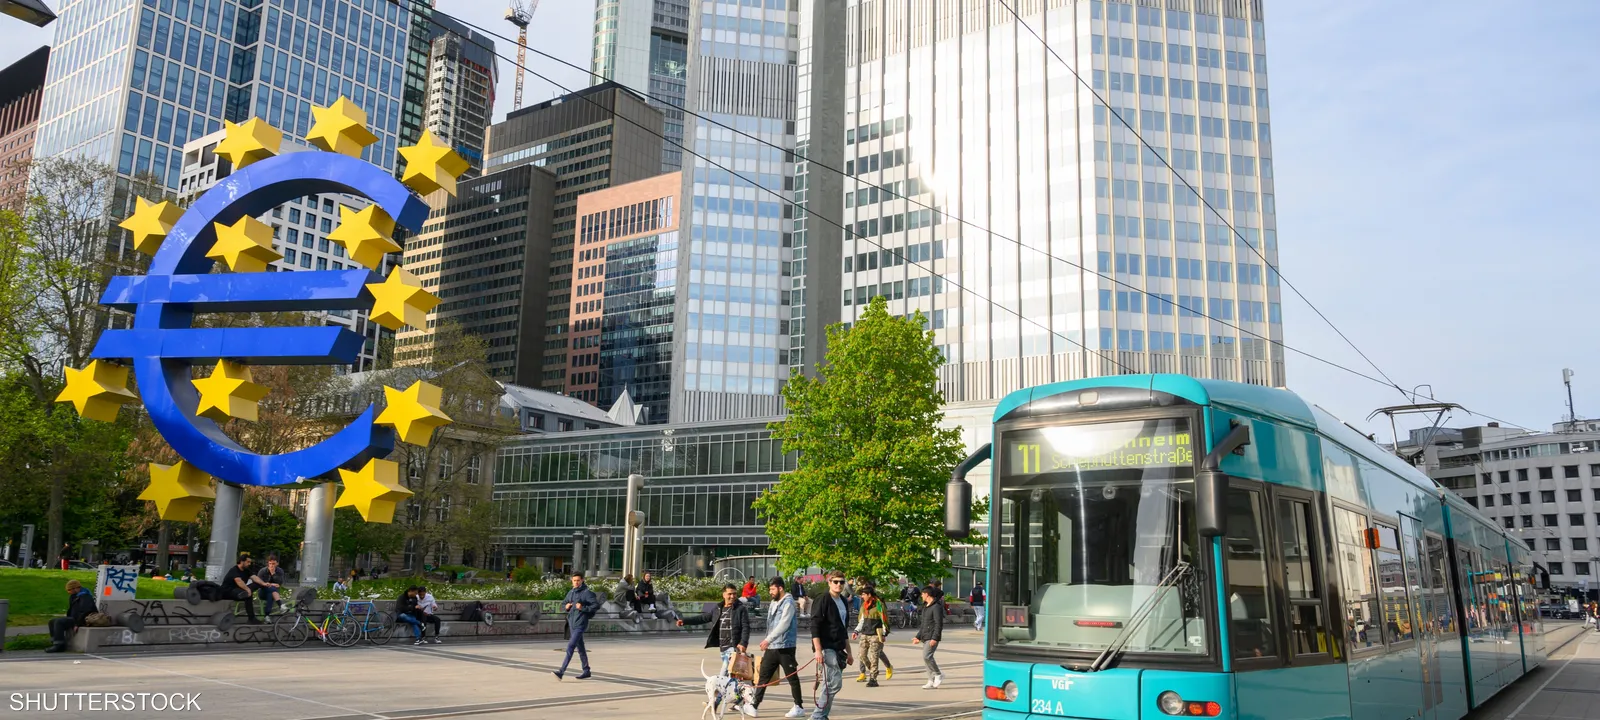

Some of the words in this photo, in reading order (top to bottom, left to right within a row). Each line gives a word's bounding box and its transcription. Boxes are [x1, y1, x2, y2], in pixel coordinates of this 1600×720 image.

[1018, 444, 1041, 474] 11
[1031, 698, 1052, 714] 234
[1055, 701, 1064, 715] A
